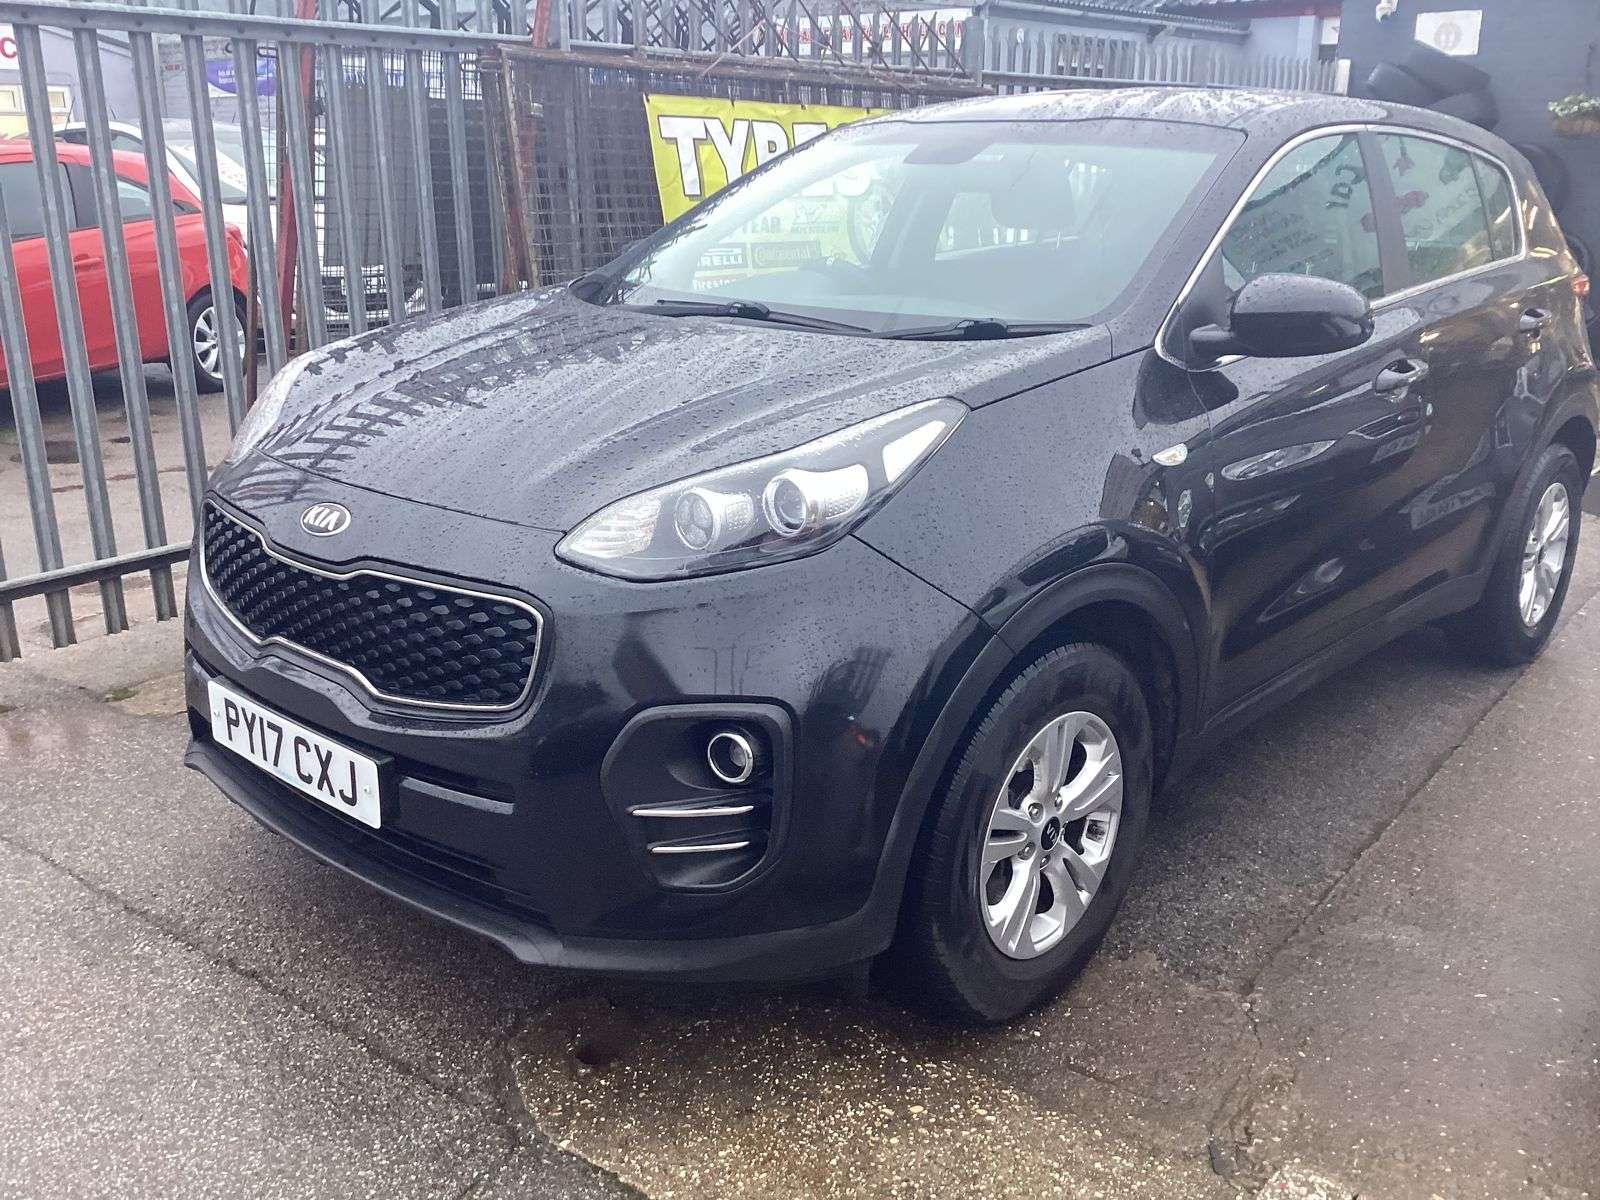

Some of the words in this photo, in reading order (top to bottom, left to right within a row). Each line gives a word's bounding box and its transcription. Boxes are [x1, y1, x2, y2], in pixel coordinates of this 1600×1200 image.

[304, 505, 341, 531] KIA
[224, 698, 284, 768] PY17
[294, 735, 358, 807] CXJ
